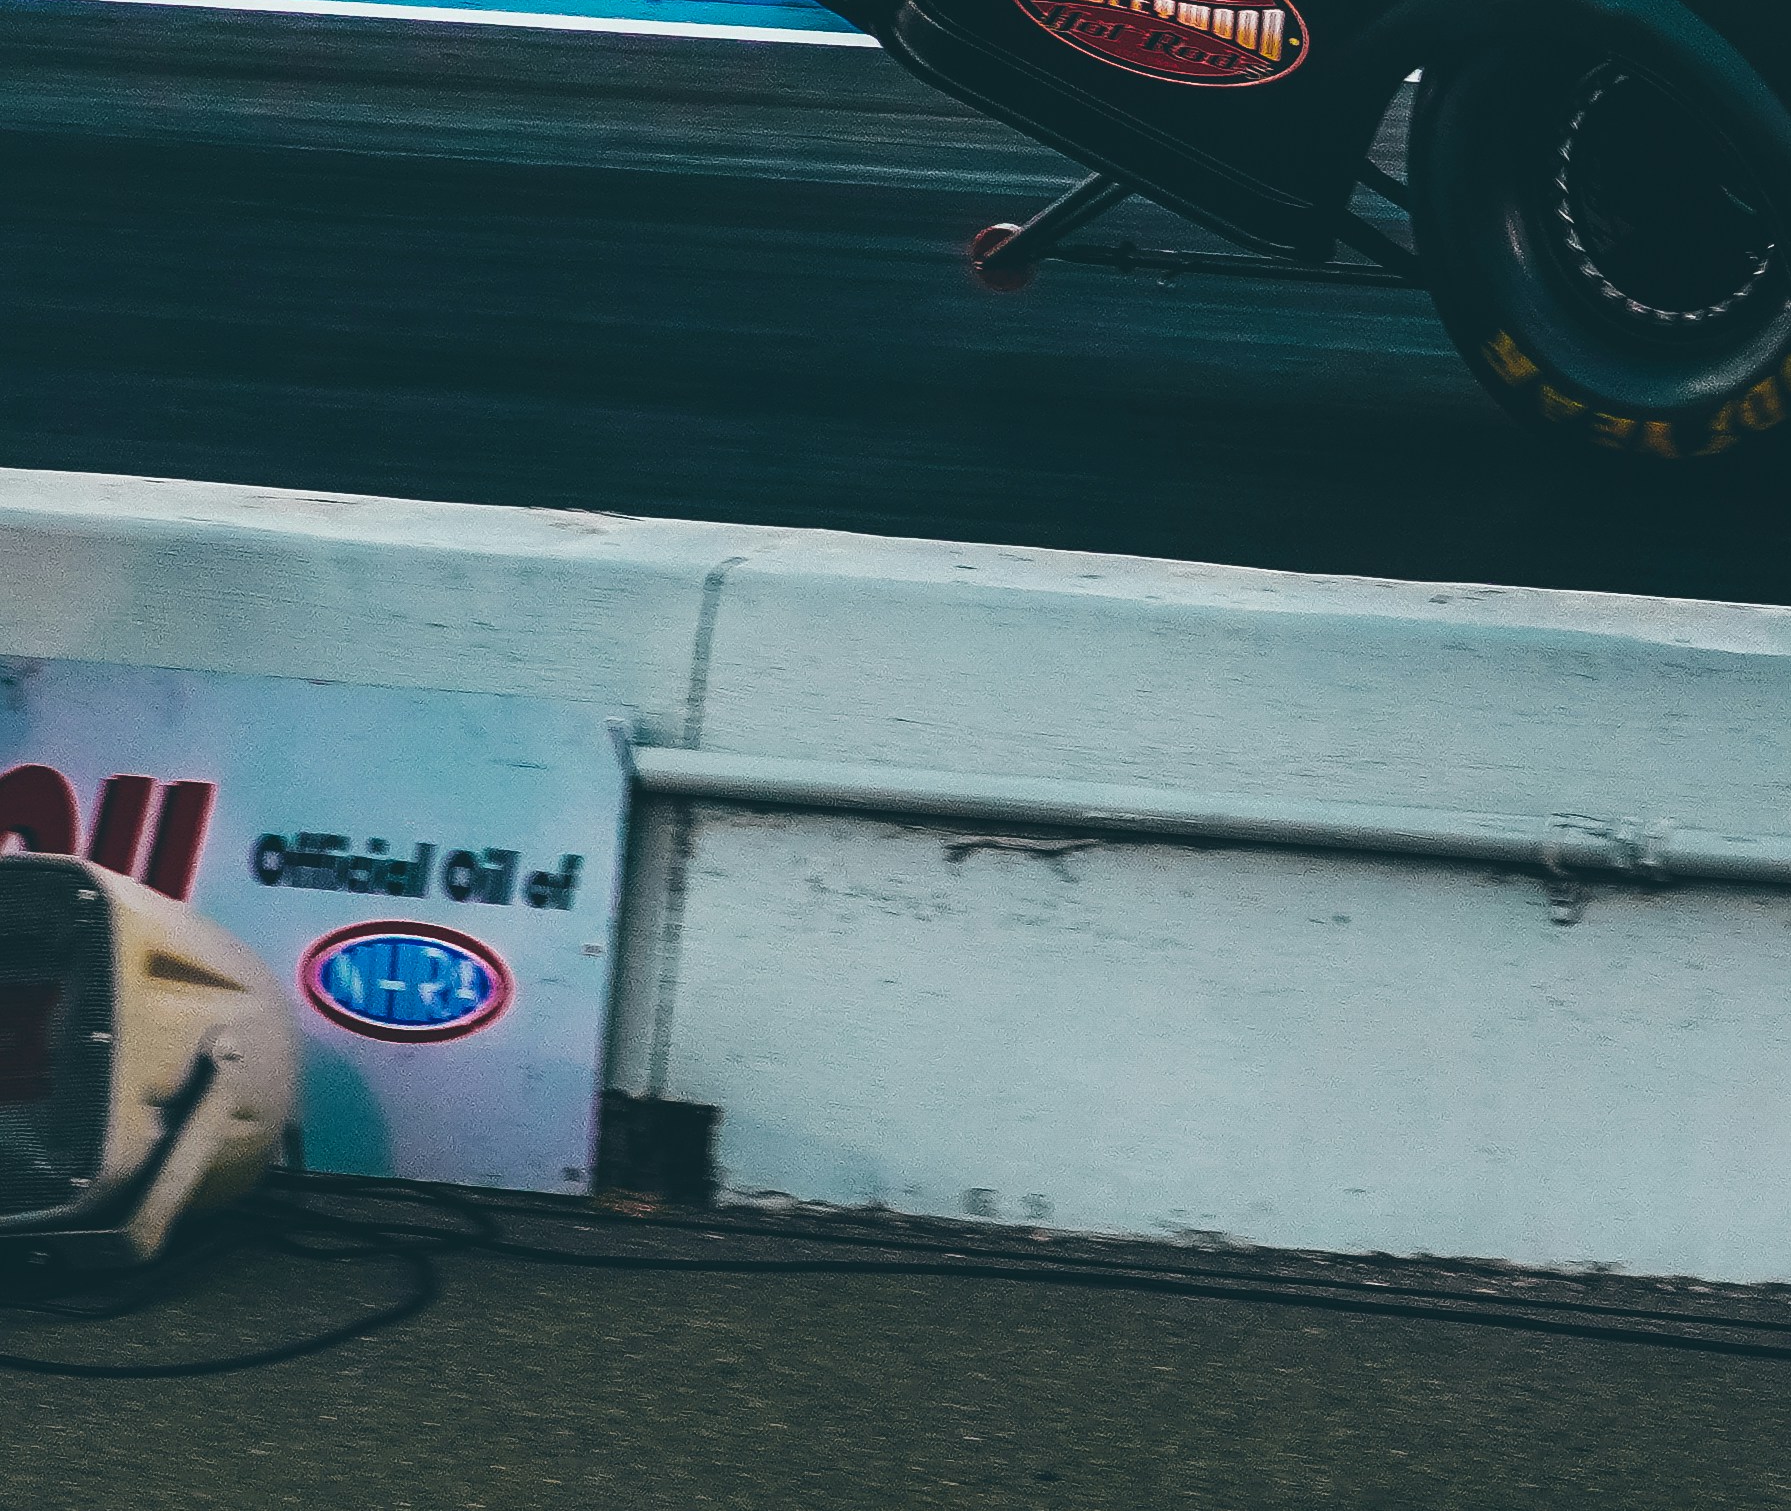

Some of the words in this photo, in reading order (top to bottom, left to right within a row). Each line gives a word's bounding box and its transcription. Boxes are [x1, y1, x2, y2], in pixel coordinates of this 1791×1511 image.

[251, 832, 435, 899] Official
[447, 847, 522, 906] Oil
[524, 854, 586, 911] of
